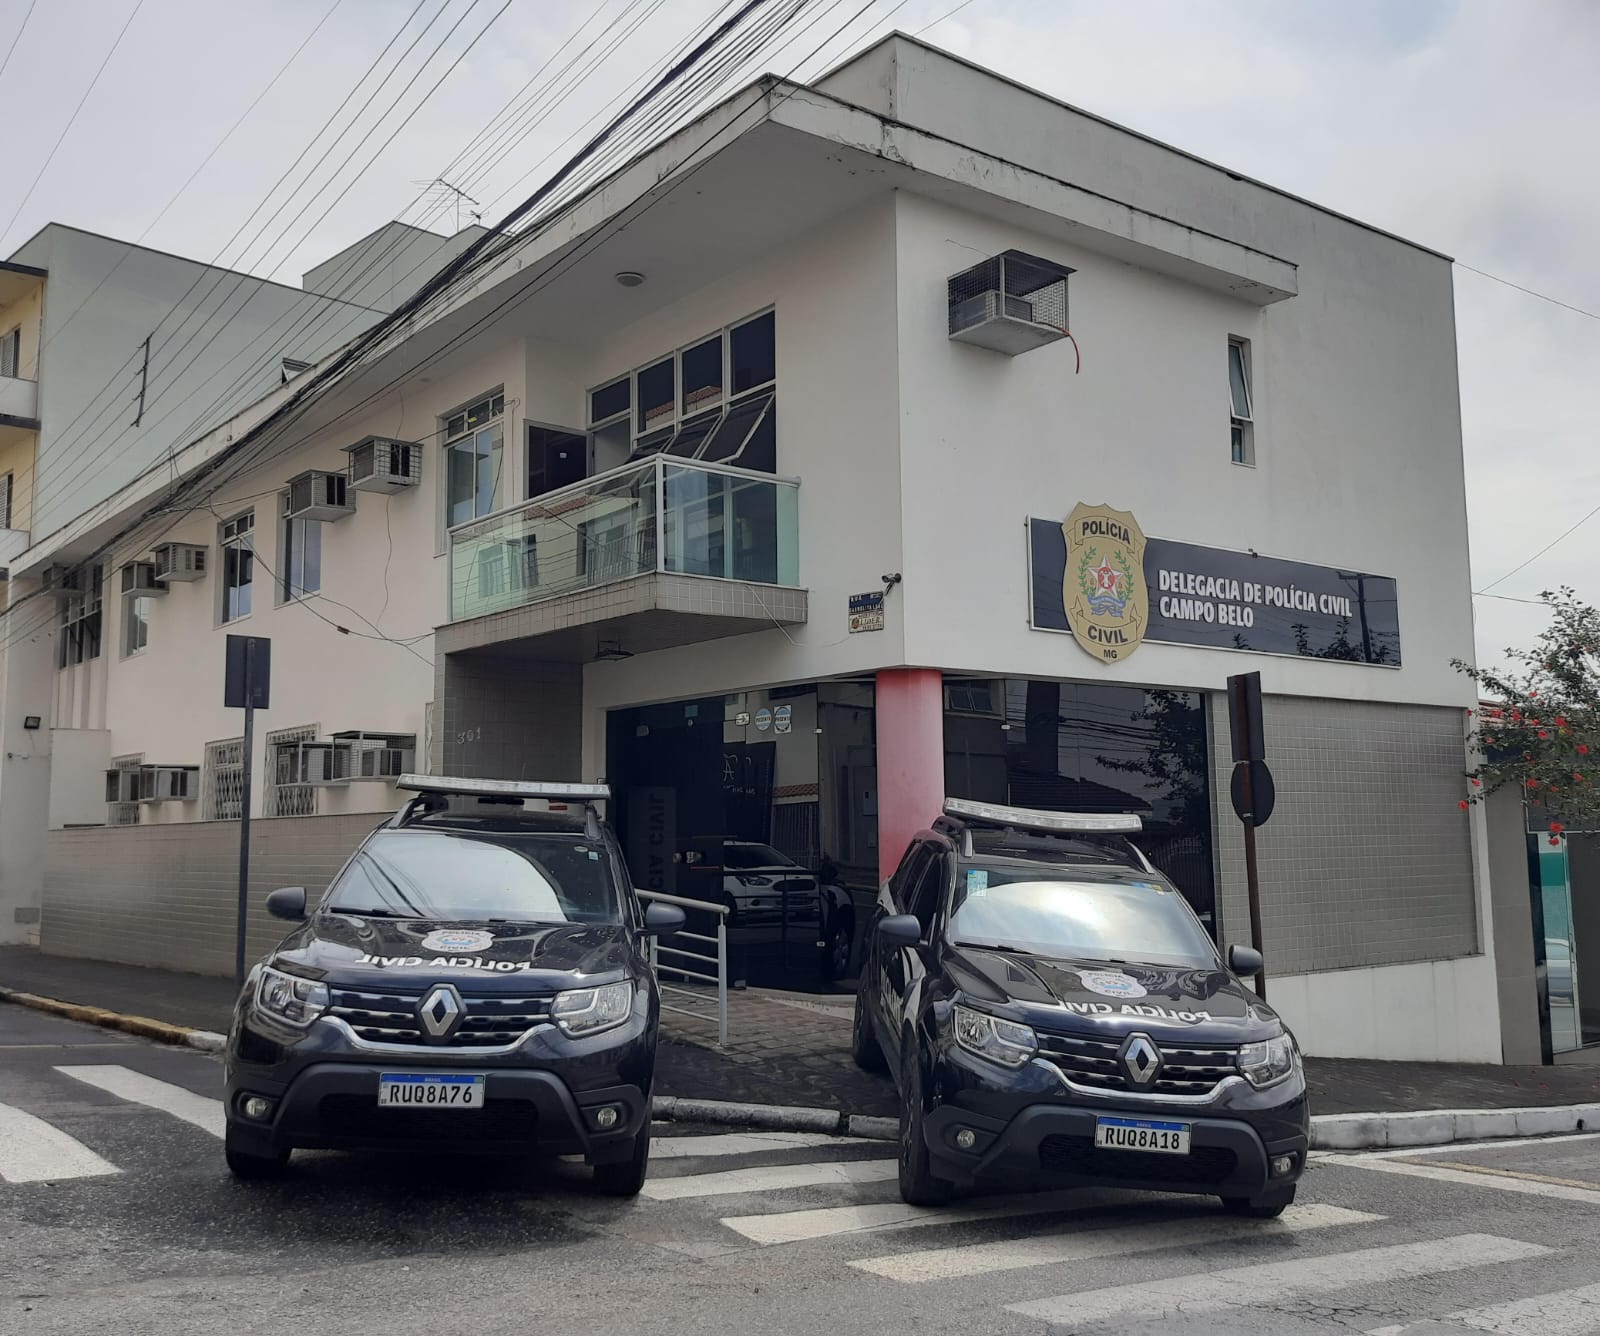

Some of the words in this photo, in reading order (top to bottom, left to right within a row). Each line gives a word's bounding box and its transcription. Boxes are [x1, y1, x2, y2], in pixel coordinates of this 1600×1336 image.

[1082, 518, 1131, 545] POLÍCIA
[1159, 569, 1241, 601] DELEGACIA
[1243, 582, 1262, 604] DE
[1264, 584, 1318, 612] POLÍCIA
[1319, 594, 1353, 617] CIVIL
[1160, 596, 1215, 623] CAMPO
[1217, 603, 1254, 628] BELO
[1087, 624, 1129, 644] CIVIL
[1103, 649, 1118, 659] MG
[389, 1084, 473, 1104] RUQ8A76
[1105, 1127, 1180, 1150] RUQ8A18
